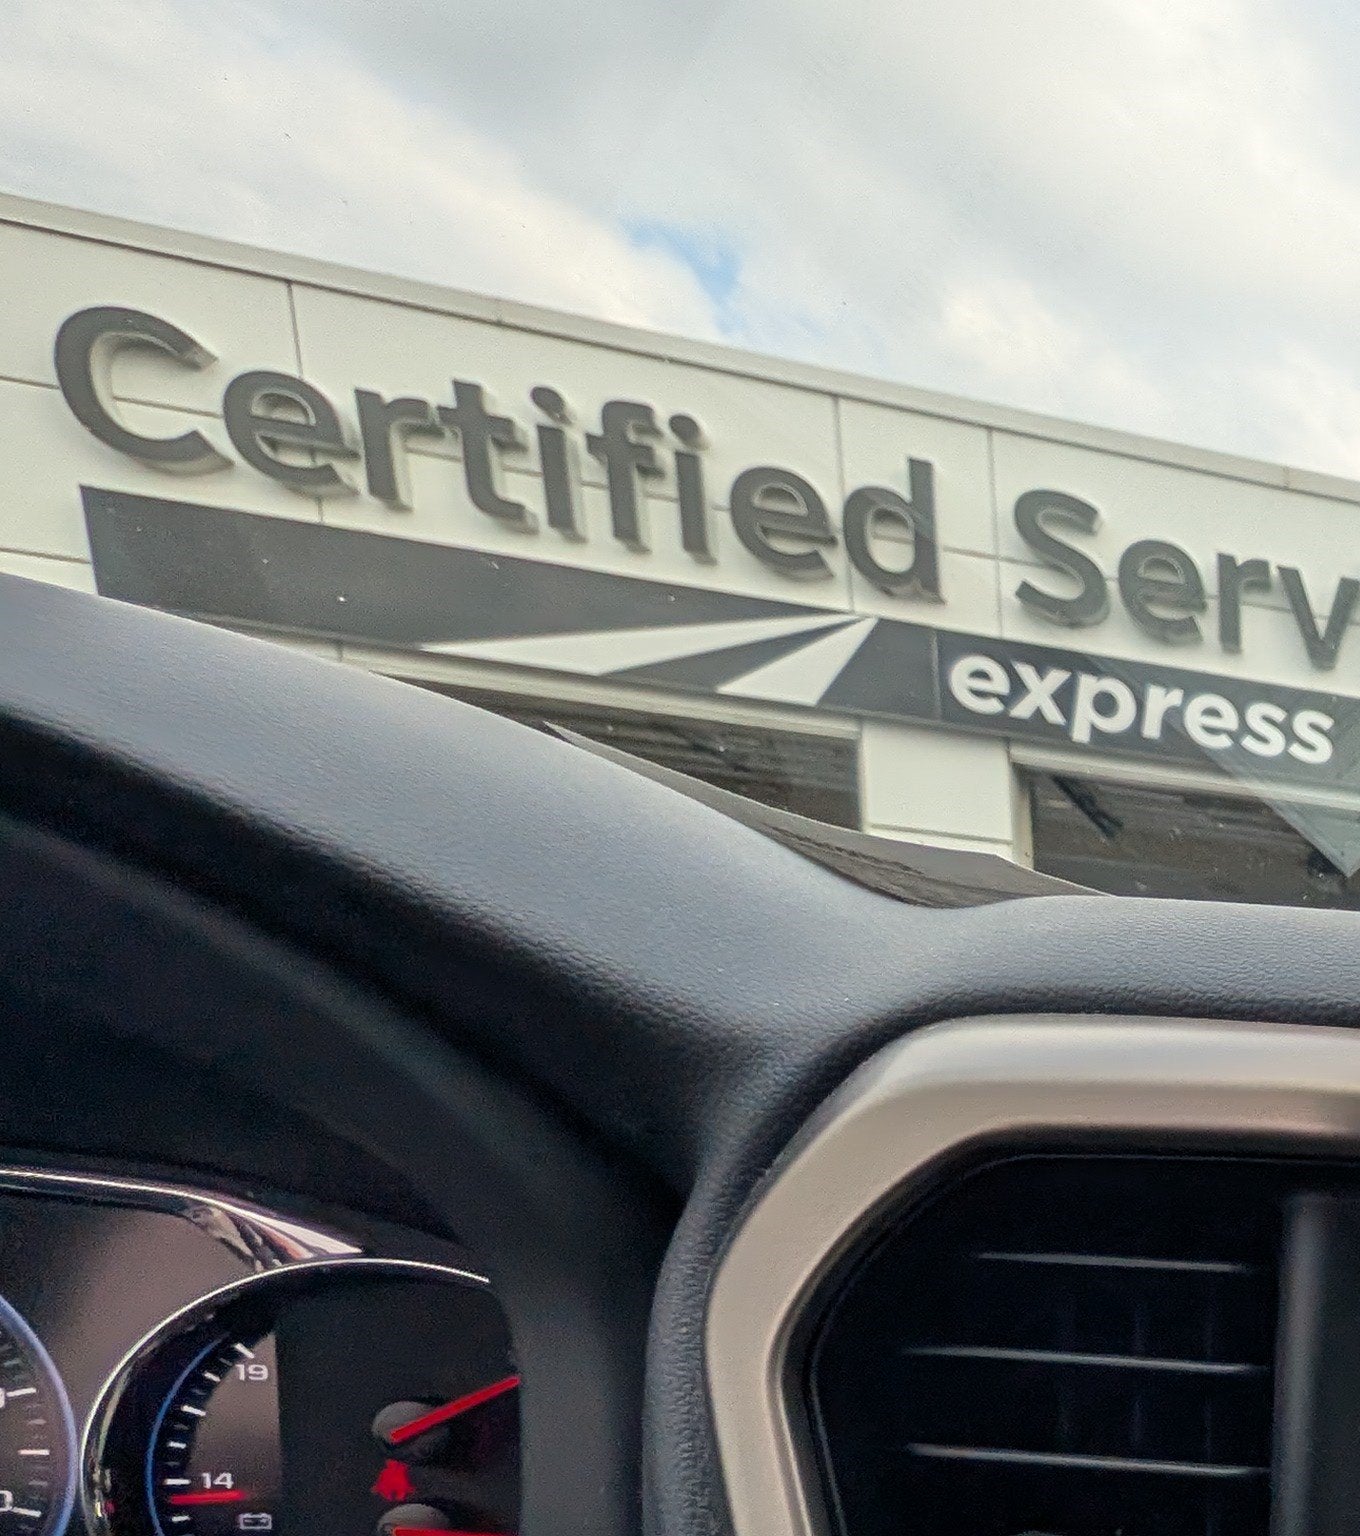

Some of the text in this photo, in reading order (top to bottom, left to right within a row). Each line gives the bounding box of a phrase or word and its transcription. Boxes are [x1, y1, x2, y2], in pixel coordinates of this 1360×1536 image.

[54, 305, 946, 604] Certified
[949, 653, 1336, 765] express
[235, 1363, 270, 1382] 19
[201, 1472, 235, 1490] 14
